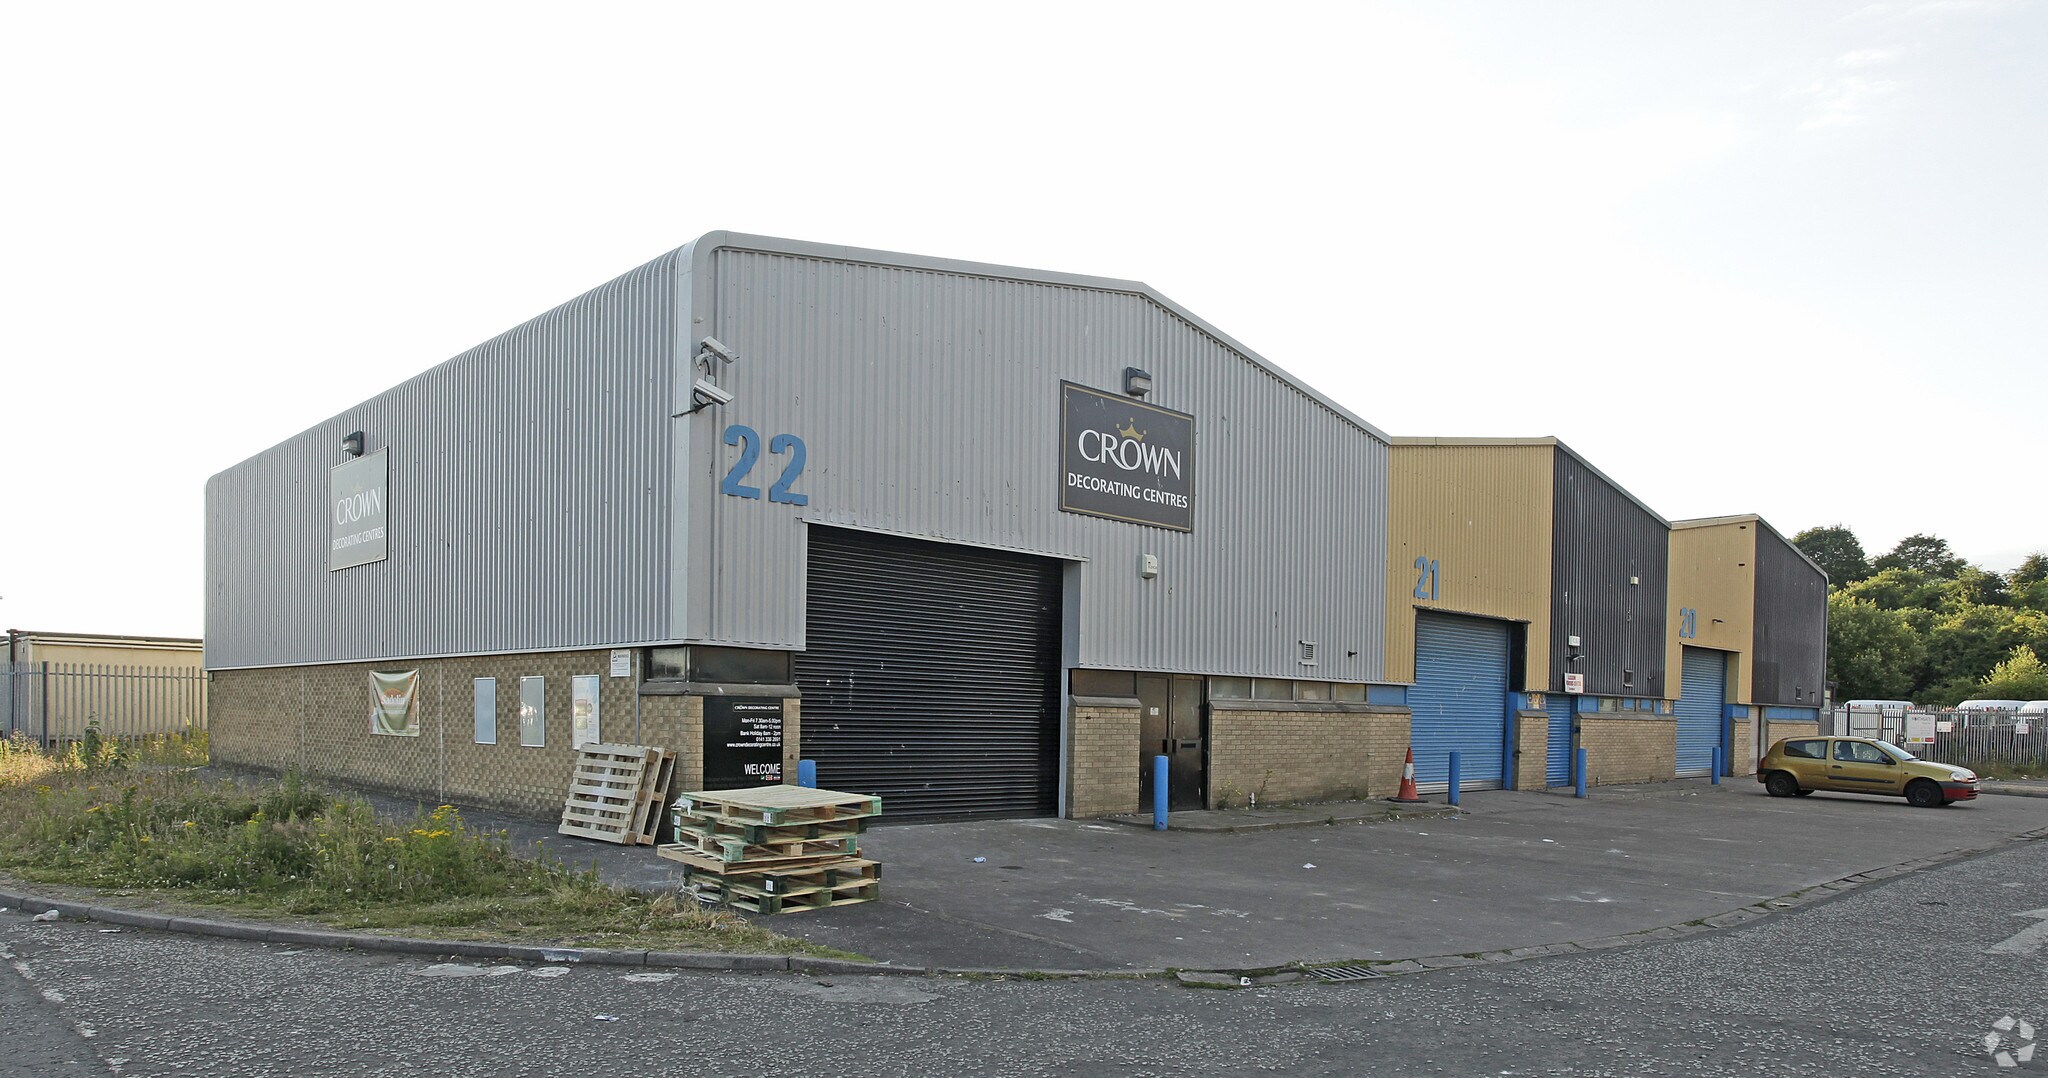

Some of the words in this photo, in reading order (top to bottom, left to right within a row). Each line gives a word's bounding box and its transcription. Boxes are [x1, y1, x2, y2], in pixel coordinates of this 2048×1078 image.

[721, 423, 809, 507] 22
[1078, 429, 1181, 481] CROWN
[336, 486, 381, 525] CROWN
[1067, 472, 1141, 500] DECORATING
[1143, 488, 1188, 509] CENTRES
[332, 532, 361, 551] DECORATING
[362, 526, 385, 543] CENTRES
[1413, 555, 1440, 602] 21
[1679, 606, 1697, 639] 20
[744, 763, 781, 775] WELCOME
